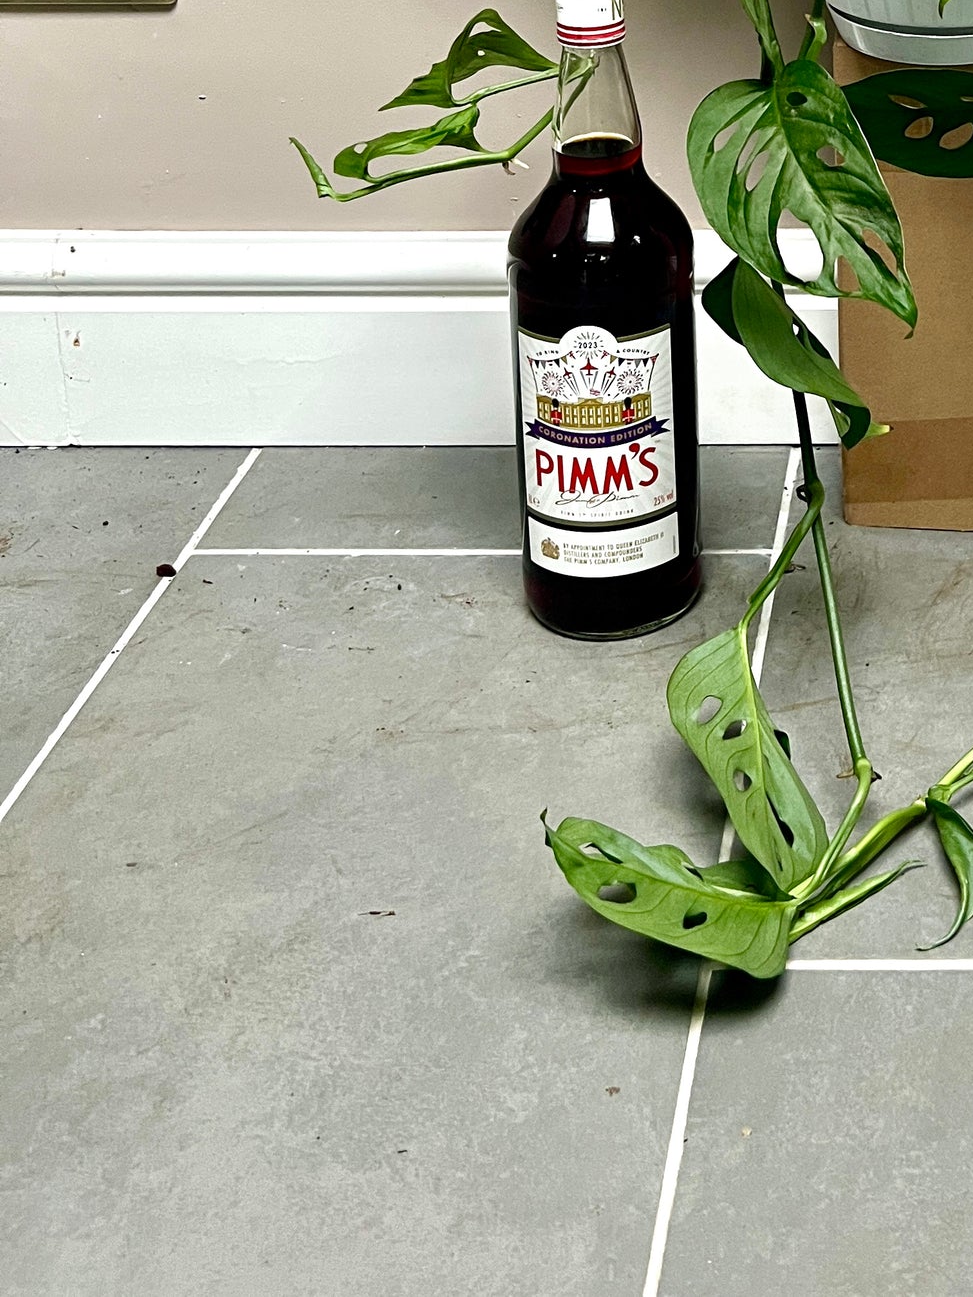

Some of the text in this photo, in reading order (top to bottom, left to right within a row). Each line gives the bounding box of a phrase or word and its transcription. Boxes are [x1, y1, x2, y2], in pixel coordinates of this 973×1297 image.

[578, 341, 598, 349] 2023
[538, 422, 652, 444] CORONATION EDITION
[535, 442, 659, 495] PIMM'S
[616, 541, 633, 549] QUEEN
[622, 553, 644, 563] LONDON
